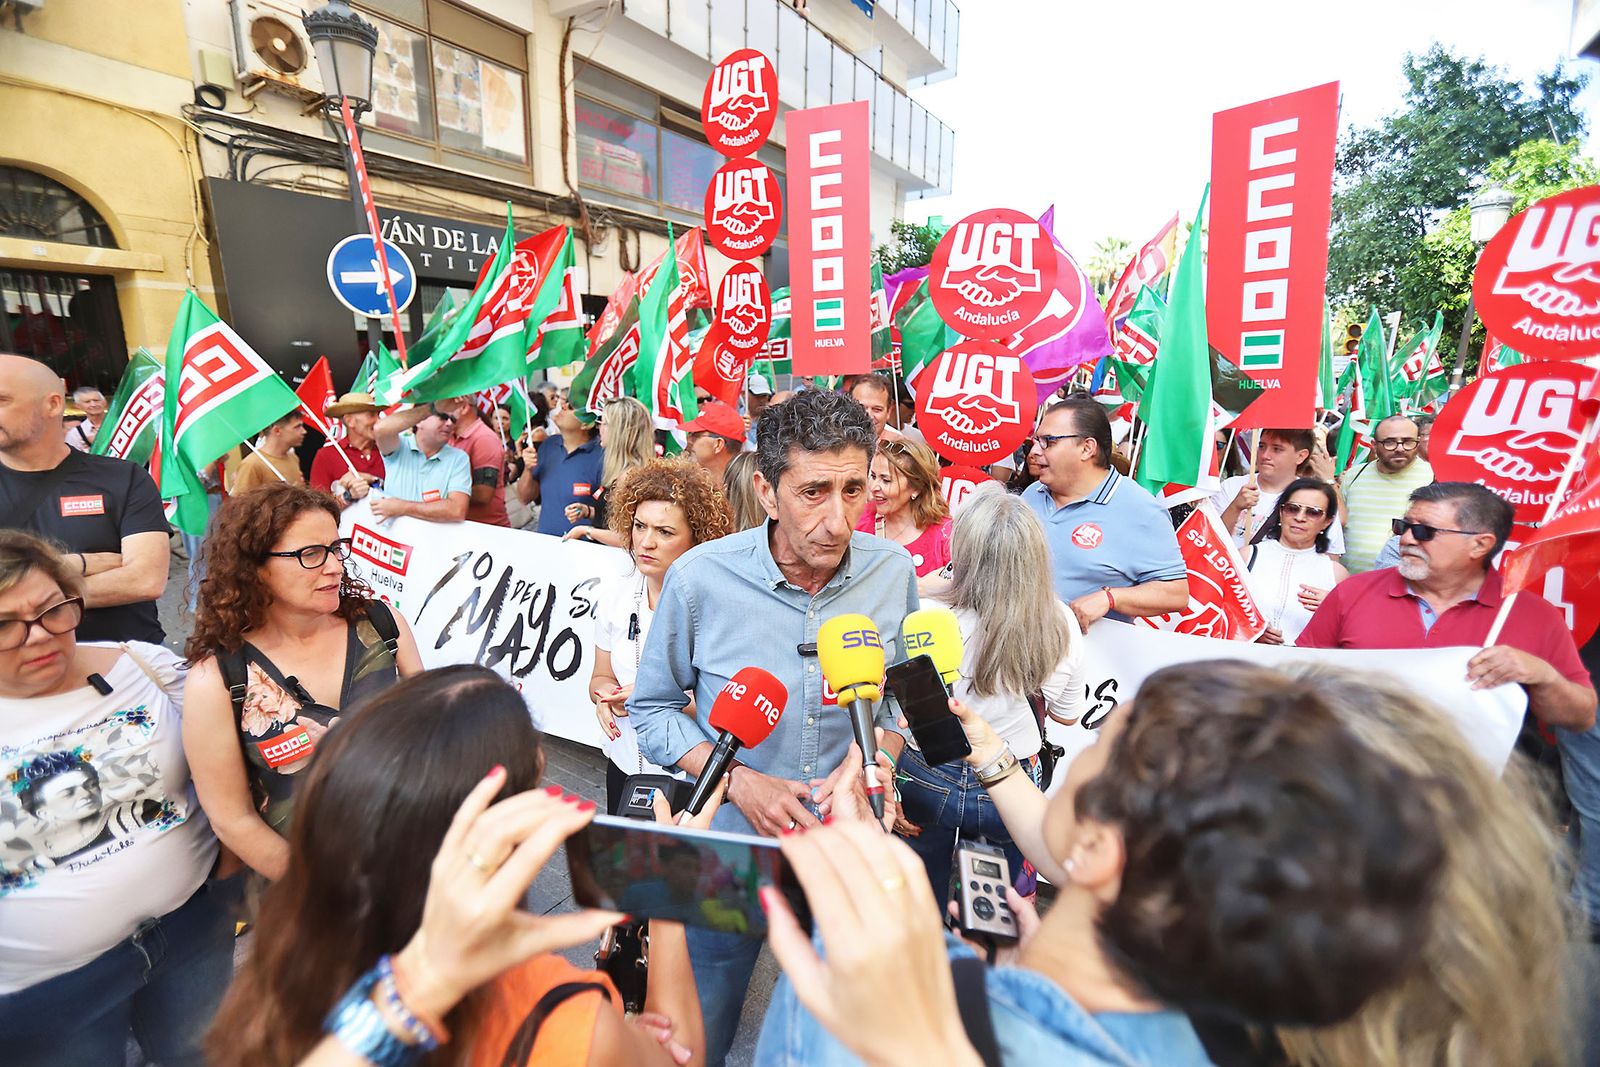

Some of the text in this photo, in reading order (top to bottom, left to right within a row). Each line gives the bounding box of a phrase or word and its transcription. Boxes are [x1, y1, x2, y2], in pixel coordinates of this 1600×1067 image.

[711, 56, 766, 104] UGT
[718, 128, 761, 147] Andalucía
[714, 167, 769, 206] UGT
[432, 226, 467, 252] DE
[722, 235, 765, 250] Andalucía
[949, 223, 1041, 273] UGT
[1507, 206, 1600, 272] UG
[723, 271, 764, 309] UGT
[954, 306, 1021, 326] Andalucía
[1512, 317, 1600, 341] Andaluc
[814, 338, 845, 348] HUELVA
[932, 352, 1021, 401] UGT
[1239, 378, 1281, 390] HUELVA
[937, 431, 1001, 453] Andalucía
[371, 567, 404, 592] Huelva
[511, 580, 536, 605] DE
[434, 565, 583, 681] MAYO
[753, 693, 780, 726] rne
